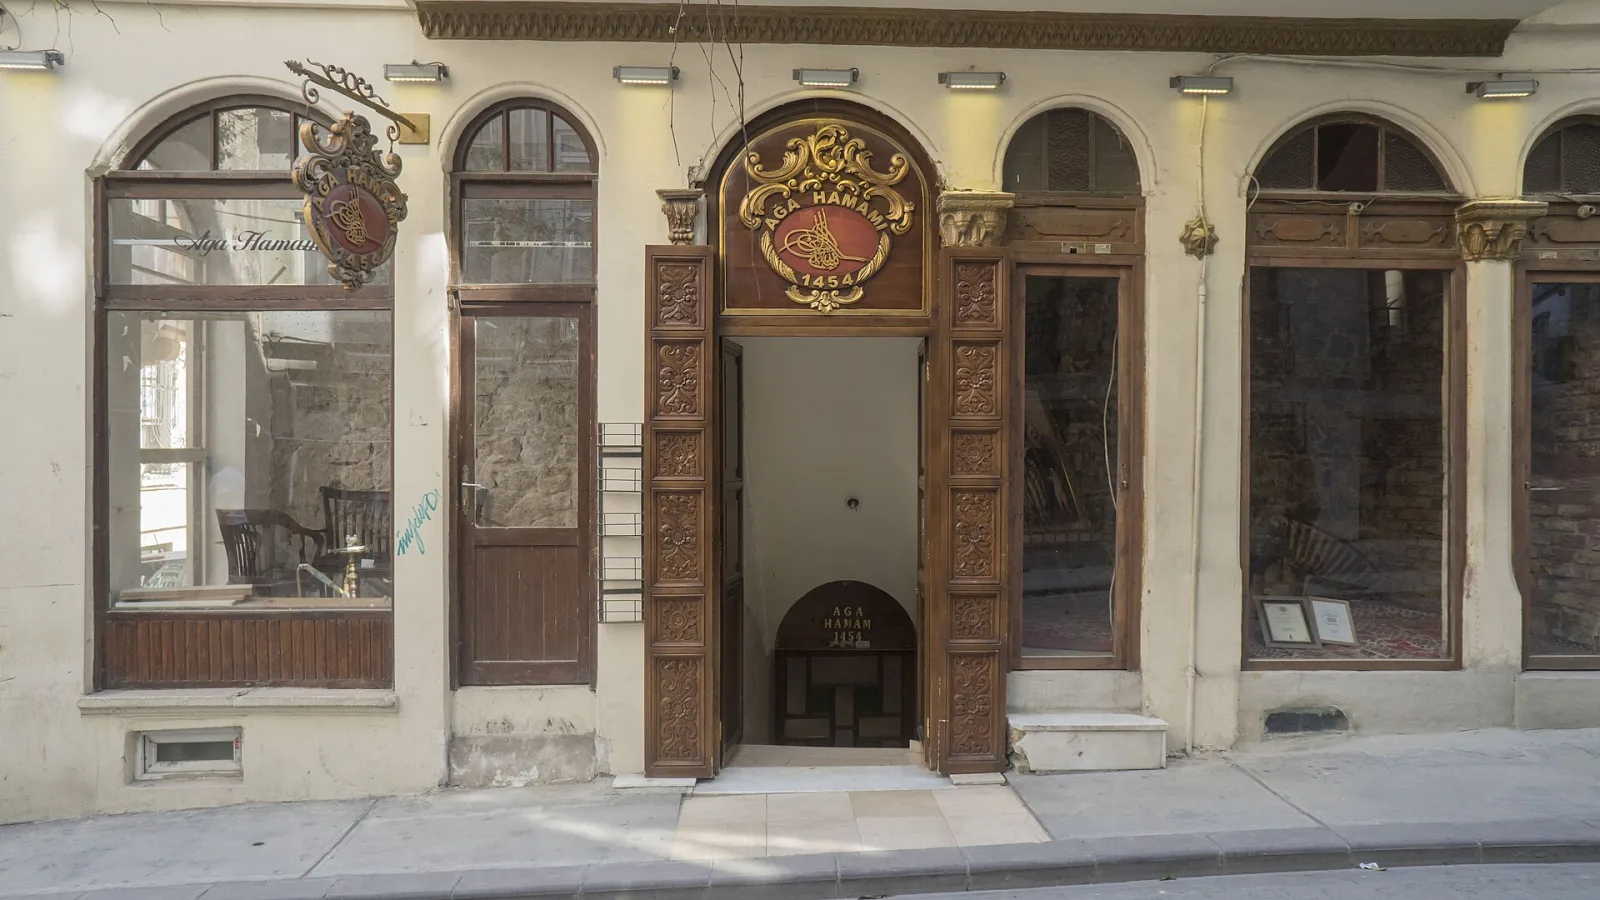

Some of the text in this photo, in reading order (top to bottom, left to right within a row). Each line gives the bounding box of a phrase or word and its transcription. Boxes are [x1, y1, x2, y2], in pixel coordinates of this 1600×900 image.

[764, 191, 888, 231] AĞA HAMAMI
[173, 229, 228, 257] Aga
[335, 248, 381, 267] 1454
[801, 273, 854, 288] 1454
[833, 606, 863, 616] AGA
[824, 618, 871, 629] HAMAM
[833, 631, 862, 641] 1454
